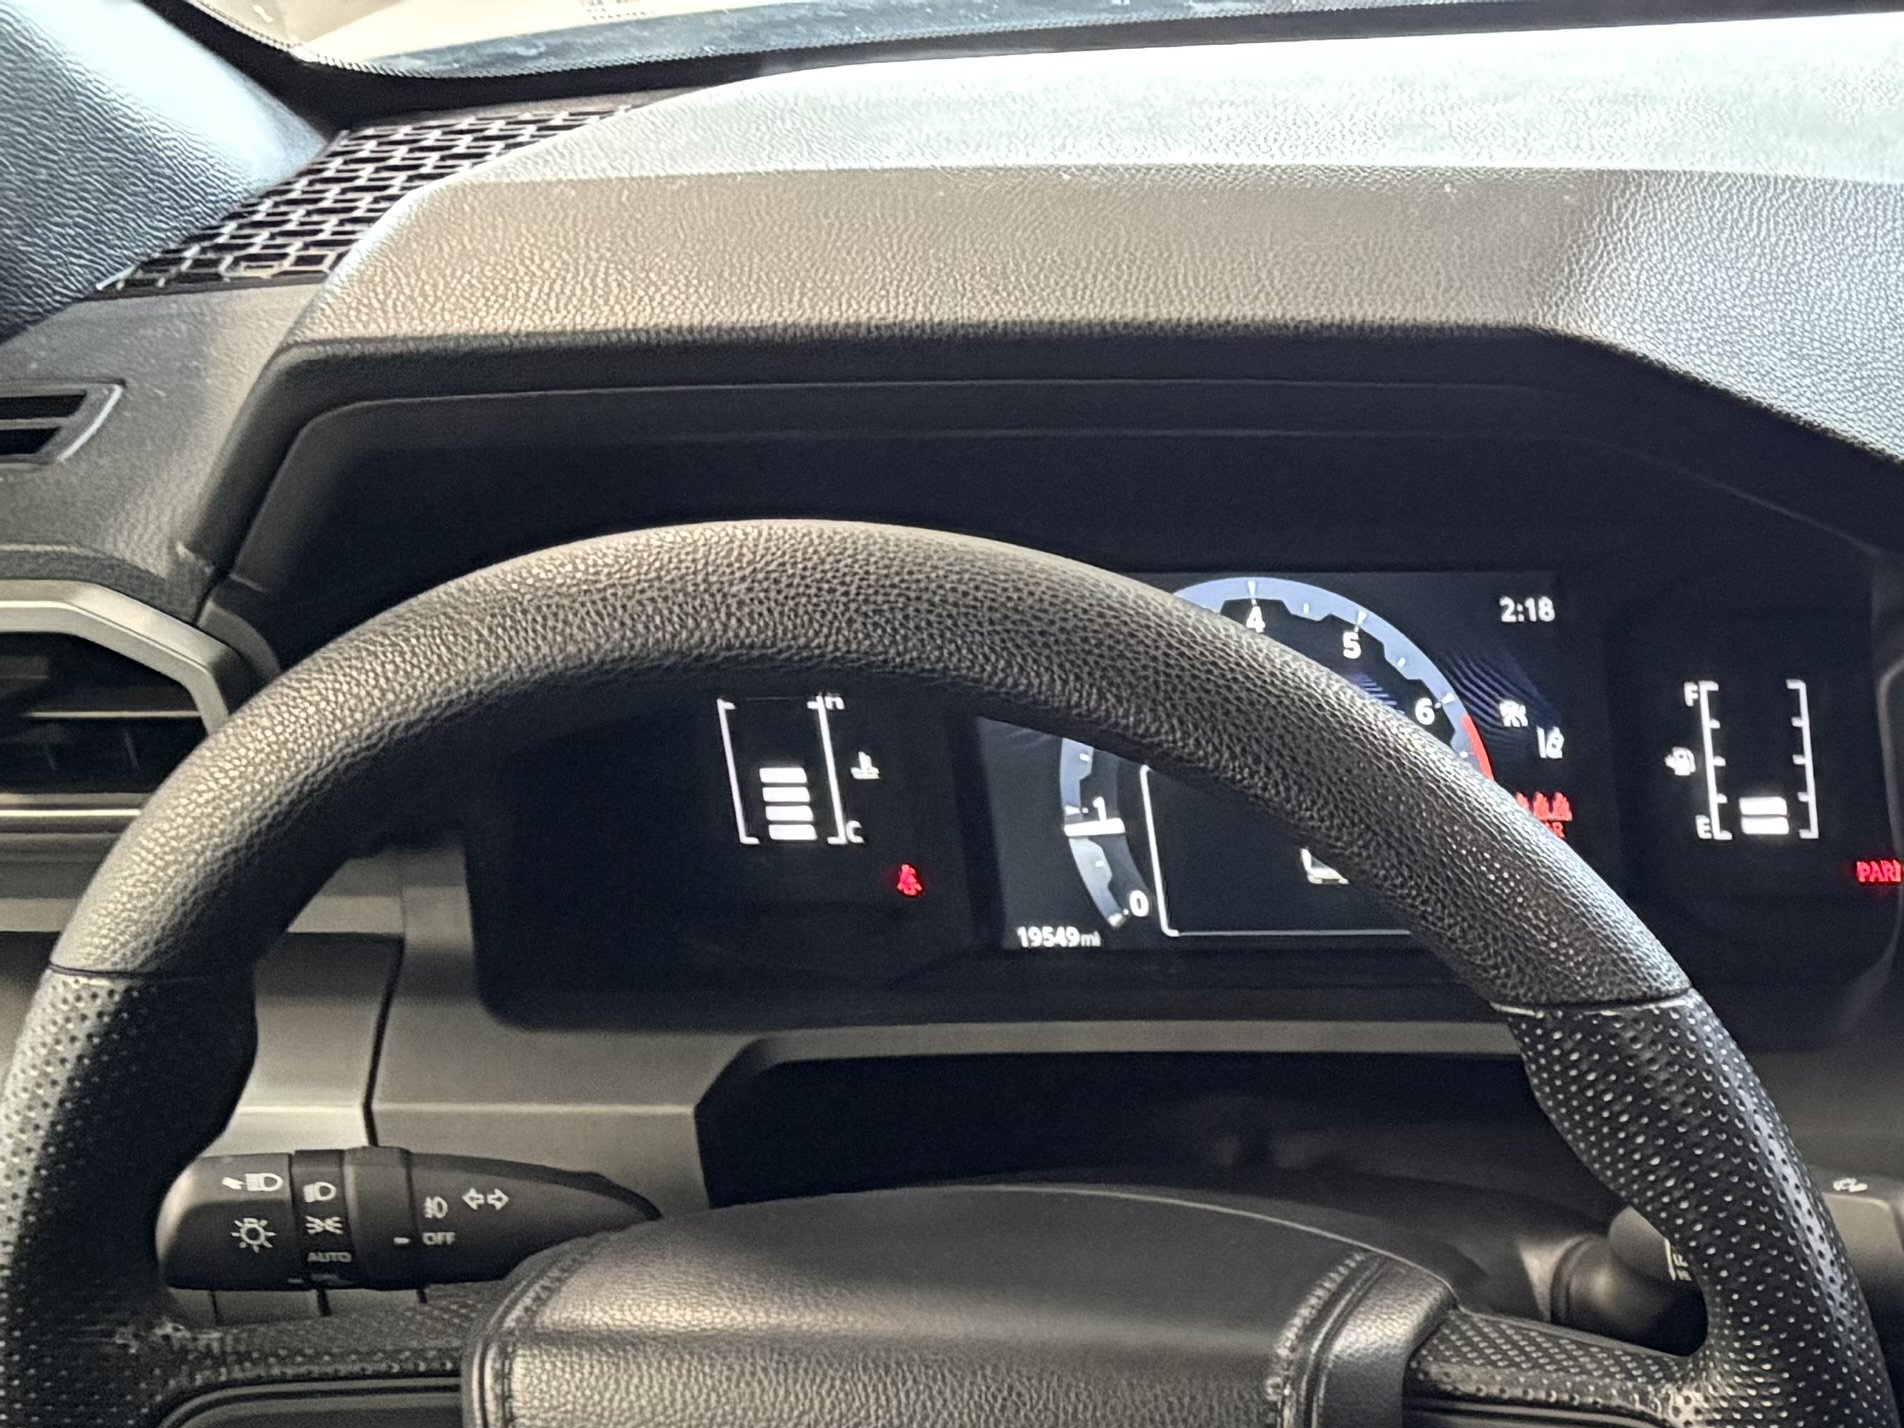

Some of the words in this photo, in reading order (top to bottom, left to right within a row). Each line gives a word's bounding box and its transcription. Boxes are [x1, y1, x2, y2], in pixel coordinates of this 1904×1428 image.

[1245, 605, 1267, 634] 4
[1499, 595, 1556, 623] 2:18
[1342, 630, 1362, 660] 5
[1683, 681, 1699, 708] F
[1414, 696, 1436, 726] 6
[845, 819, 865, 844] C
[1695, 814, 1713, 840] E
[1129, 888, 1150, 918] 0
[422, 1231, 456, 1246] OFF
[307, 1251, 352, 1263] AUTO
